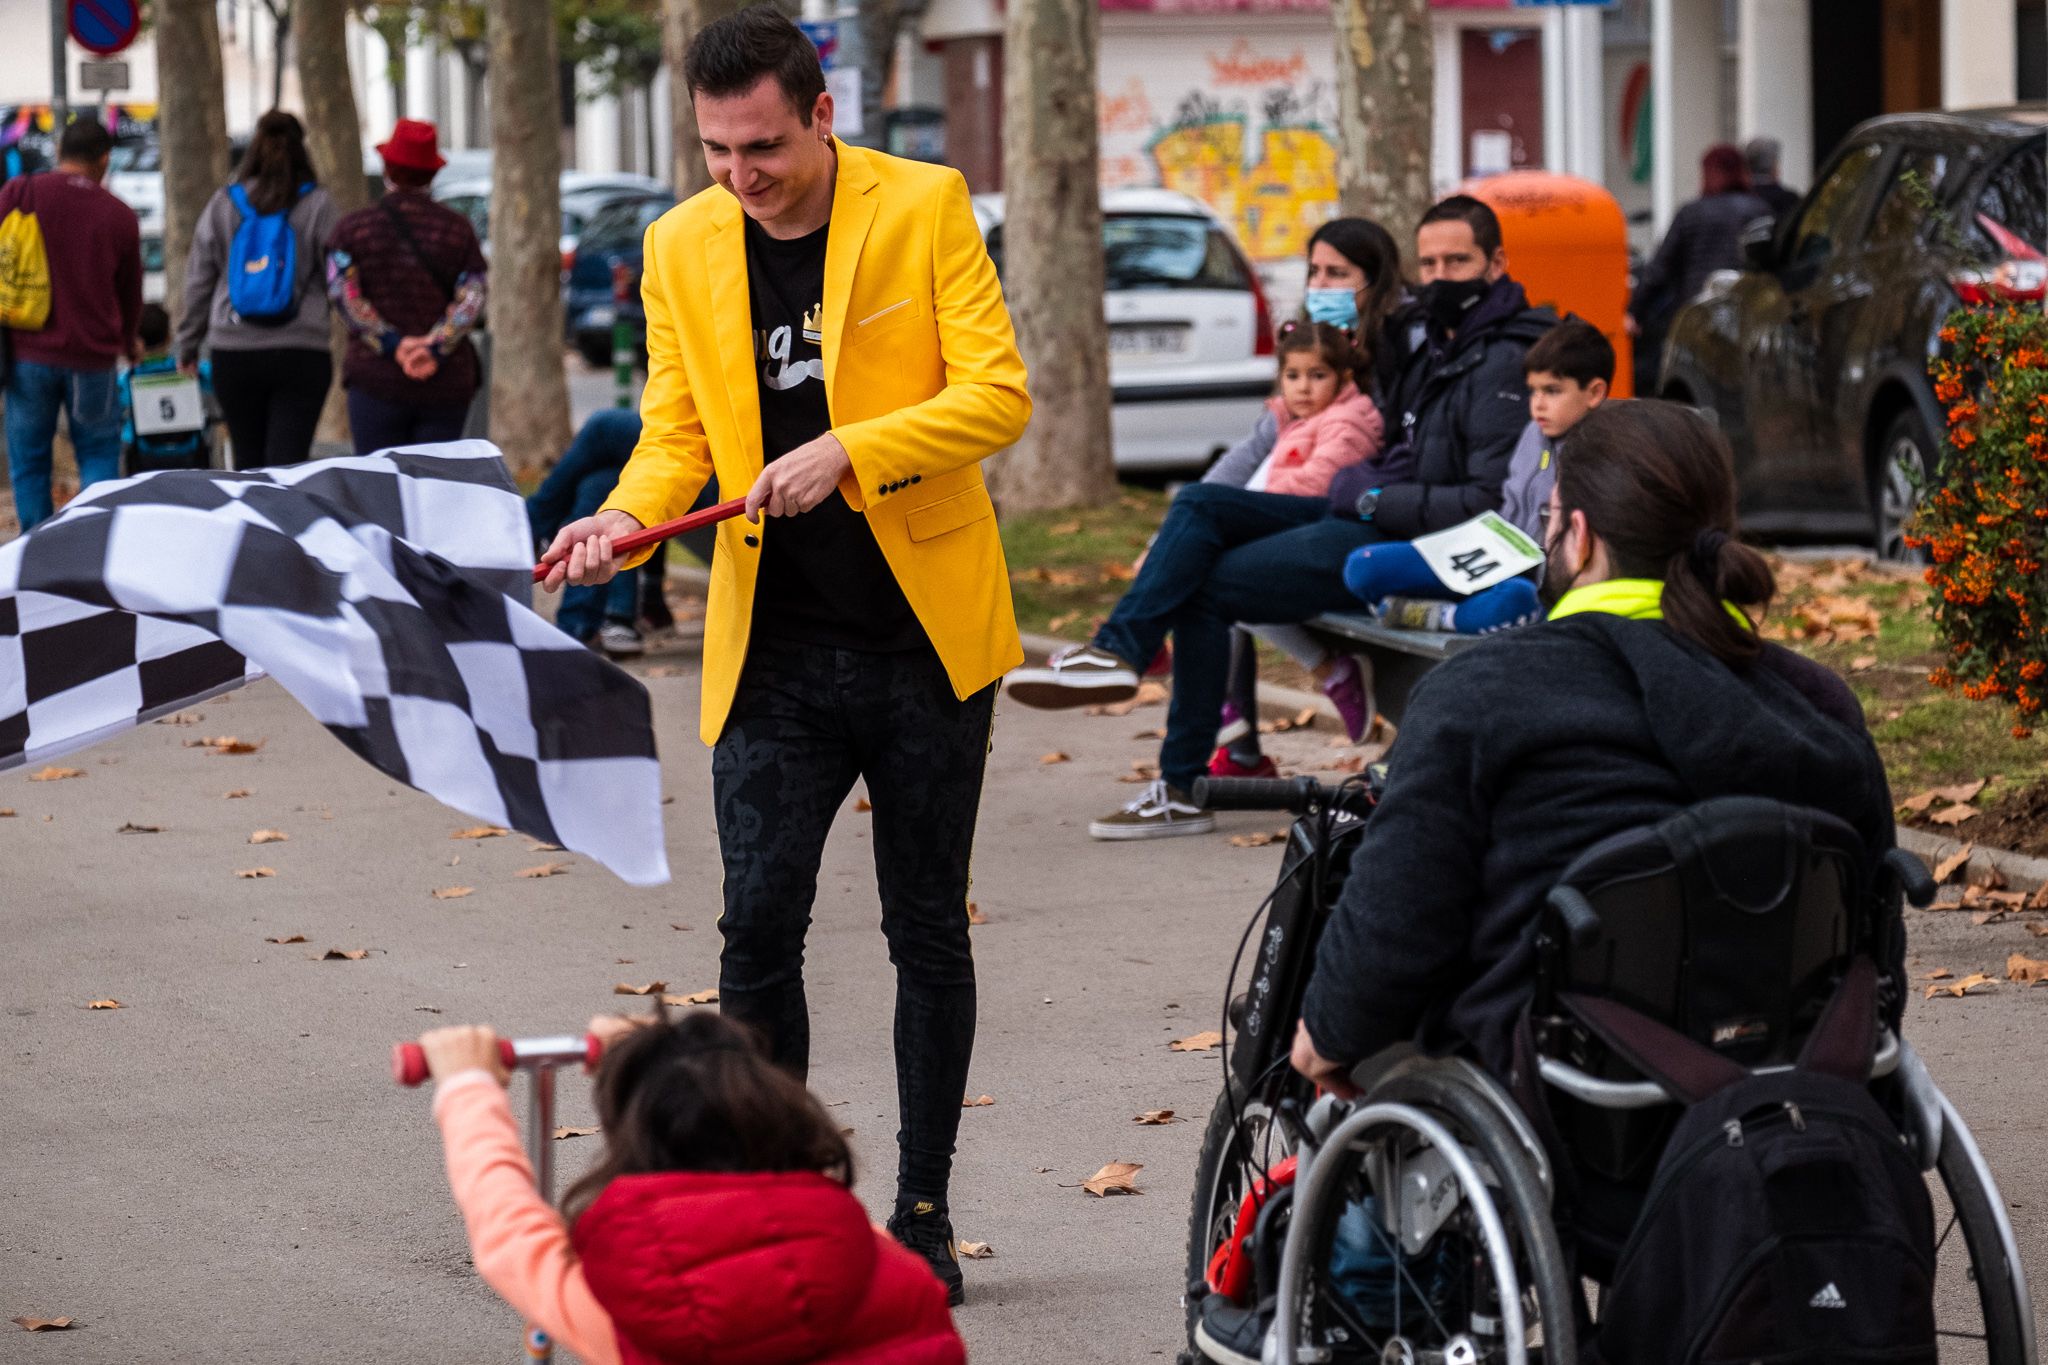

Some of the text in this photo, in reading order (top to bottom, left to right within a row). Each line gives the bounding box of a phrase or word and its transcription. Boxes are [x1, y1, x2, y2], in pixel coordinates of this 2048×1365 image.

[160, 396, 176, 423] 5
[1450, 546, 1502, 582] 44
[917, 1200, 935, 1212] NIKE
